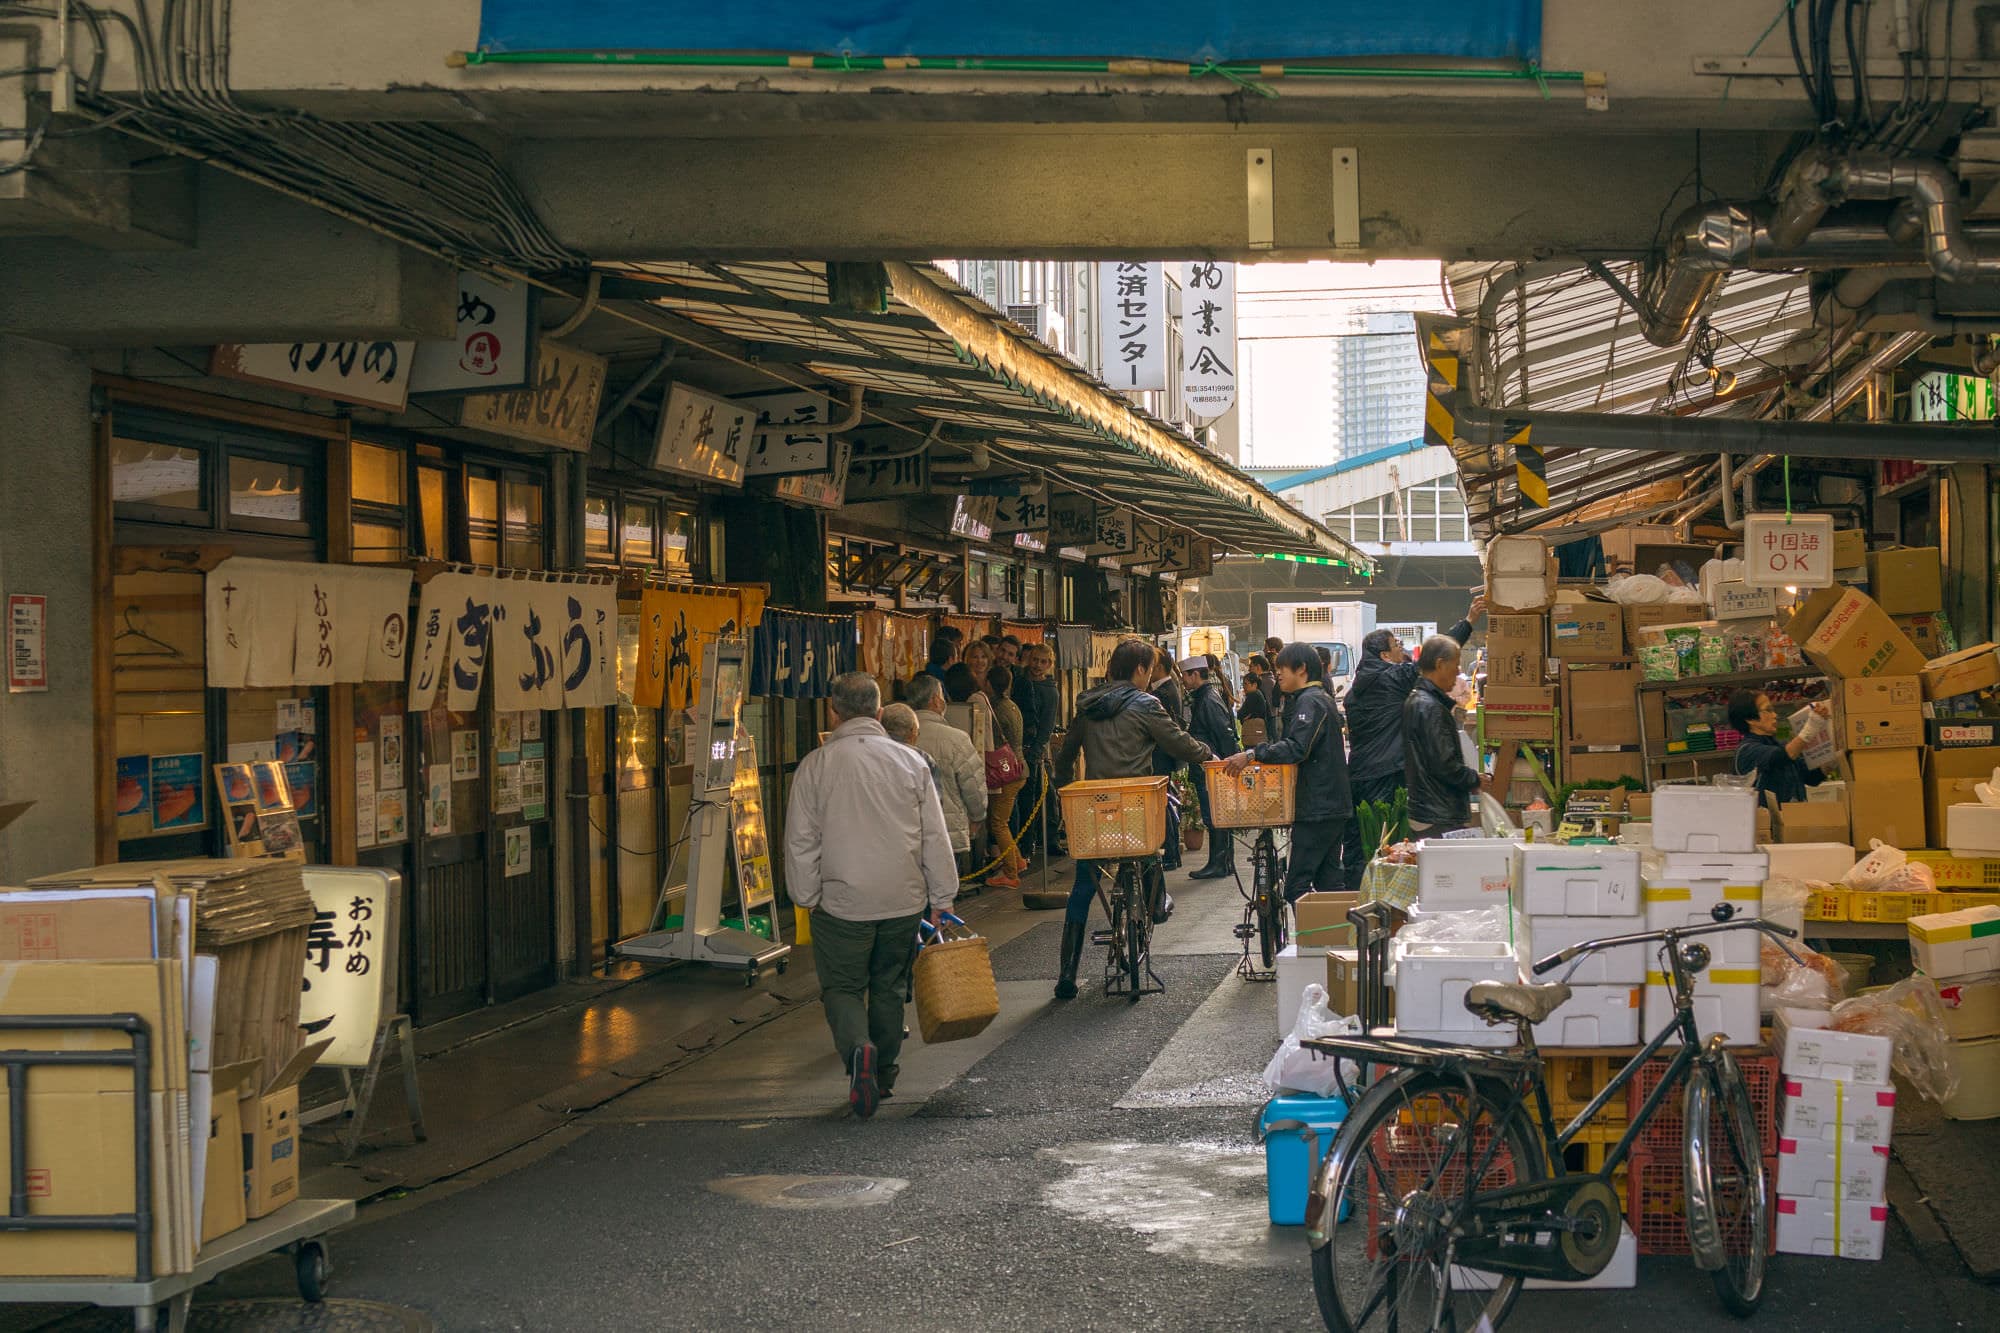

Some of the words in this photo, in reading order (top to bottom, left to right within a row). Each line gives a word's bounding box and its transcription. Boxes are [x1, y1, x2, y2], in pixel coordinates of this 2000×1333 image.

[1762, 531, 1821, 551] 中国語
[1769, 553, 1810, 572] OK
[313, 583, 333, 669] おかめ
[346, 896, 373, 976] おかめ
